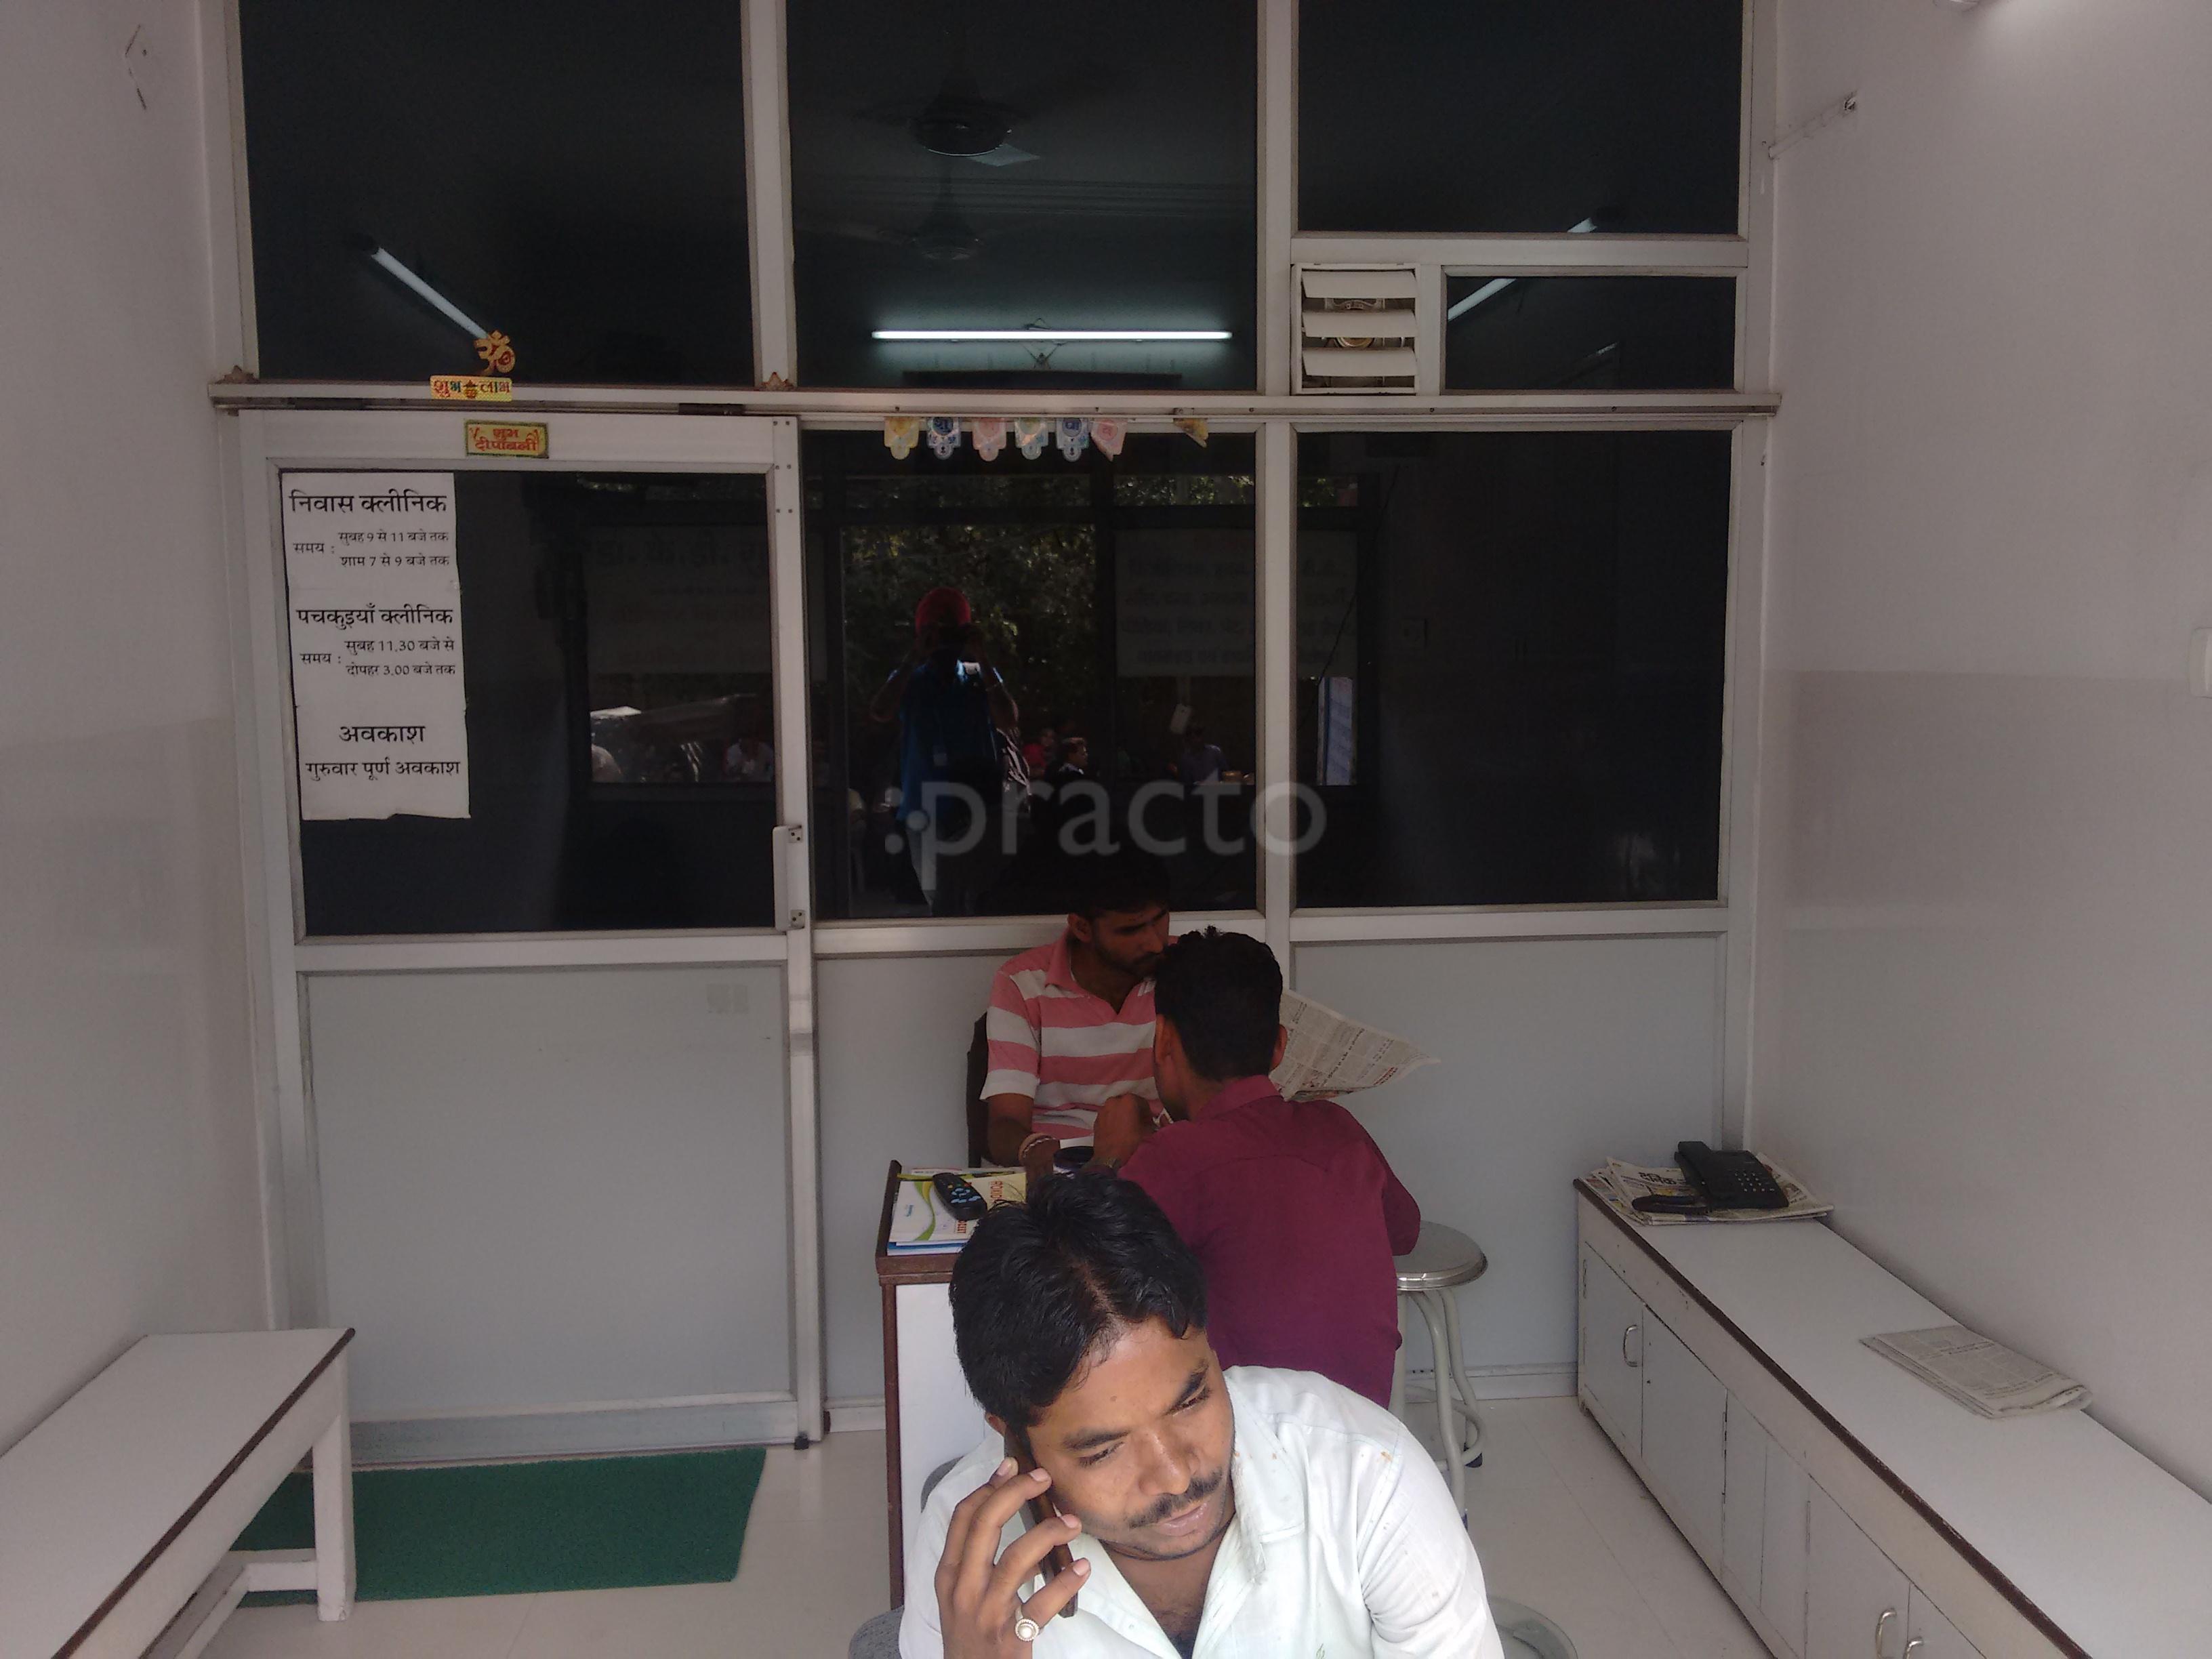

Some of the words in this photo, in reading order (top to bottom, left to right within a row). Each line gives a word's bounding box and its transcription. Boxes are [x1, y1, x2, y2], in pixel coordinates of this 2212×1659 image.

[433, 380, 463, 398] शुभ
[480, 381, 510, 394] लाभ
[288, 489, 354, 513] निवास
[359, 488, 447, 513] क्लीनिक
[338, 532, 365, 546] सुबह
[367, 532, 373, 543] 9
[377, 528, 388, 542] से
[392, 532, 404, 542] 11
[407, 528, 427, 542] बजे
[428, 531, 449, 542] तक
[293, 542, 325, 554] समय
[340, 556, 365, 568] शाम
[369, 556, 377, 567] 7
[381, 552, 391, 567] से
[394, 556, 402, 567] 9
[405, 552, 426, 567] बजे
[429, 556, 450, 566] तक
[296, 602, 376, 630] पचकुइयाँ
[378, 603, 453, 624] क्लीनिक
[344, 639, 375, 655] सुबह
[378, 640, 415, 652] 11.30
[418, 636, 440, 651] बजे
[443, 636, 455, 651] से
[300, 653, 331, 664] समय
[345, 662, 380, 676] दोपहर
[383, 665, 409, 676] 3.00
[412, 661, 433, 675] बजे
[435, 664, 456, 675] तक
[340, 725, 426, 744] अवकाश
[305, 762, 359, 781] गुरुवार
[362, 756, 390, 781] पूर्ण
[396, 761, 461, 777] अवकाश
